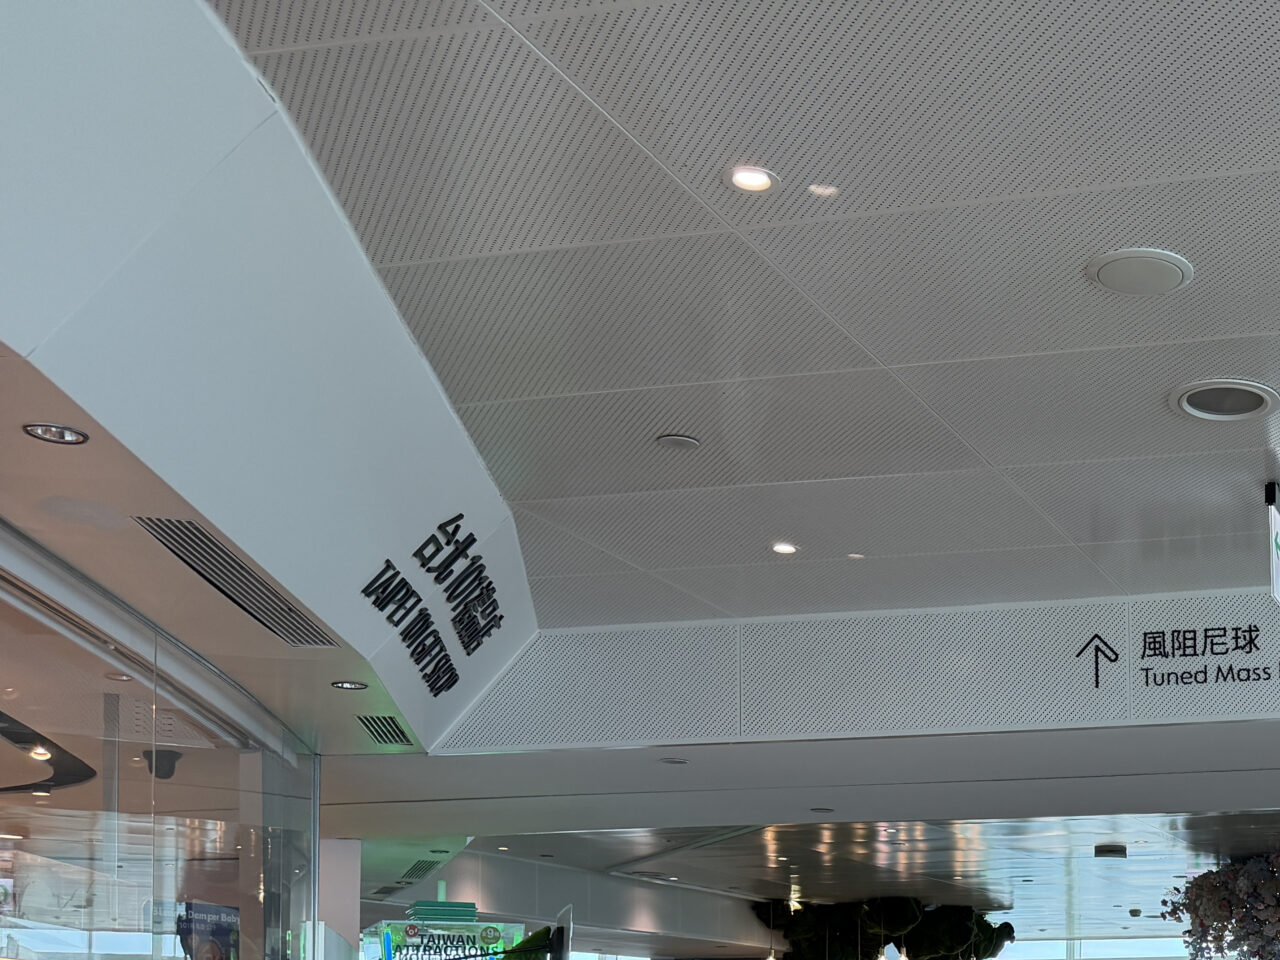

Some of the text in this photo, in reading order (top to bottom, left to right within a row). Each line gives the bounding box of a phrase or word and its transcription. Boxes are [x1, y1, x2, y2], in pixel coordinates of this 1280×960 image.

[360, 558, 460, 698] TAIPEI 101 GIFT SHOP
[1141, 624, 1261, 660] 風阻尼球
[1140, 665, 1208, 687] Tuned
[1215, 664, 1272, 684] Mass
[418, 934, 476, 945] TAIWAN
